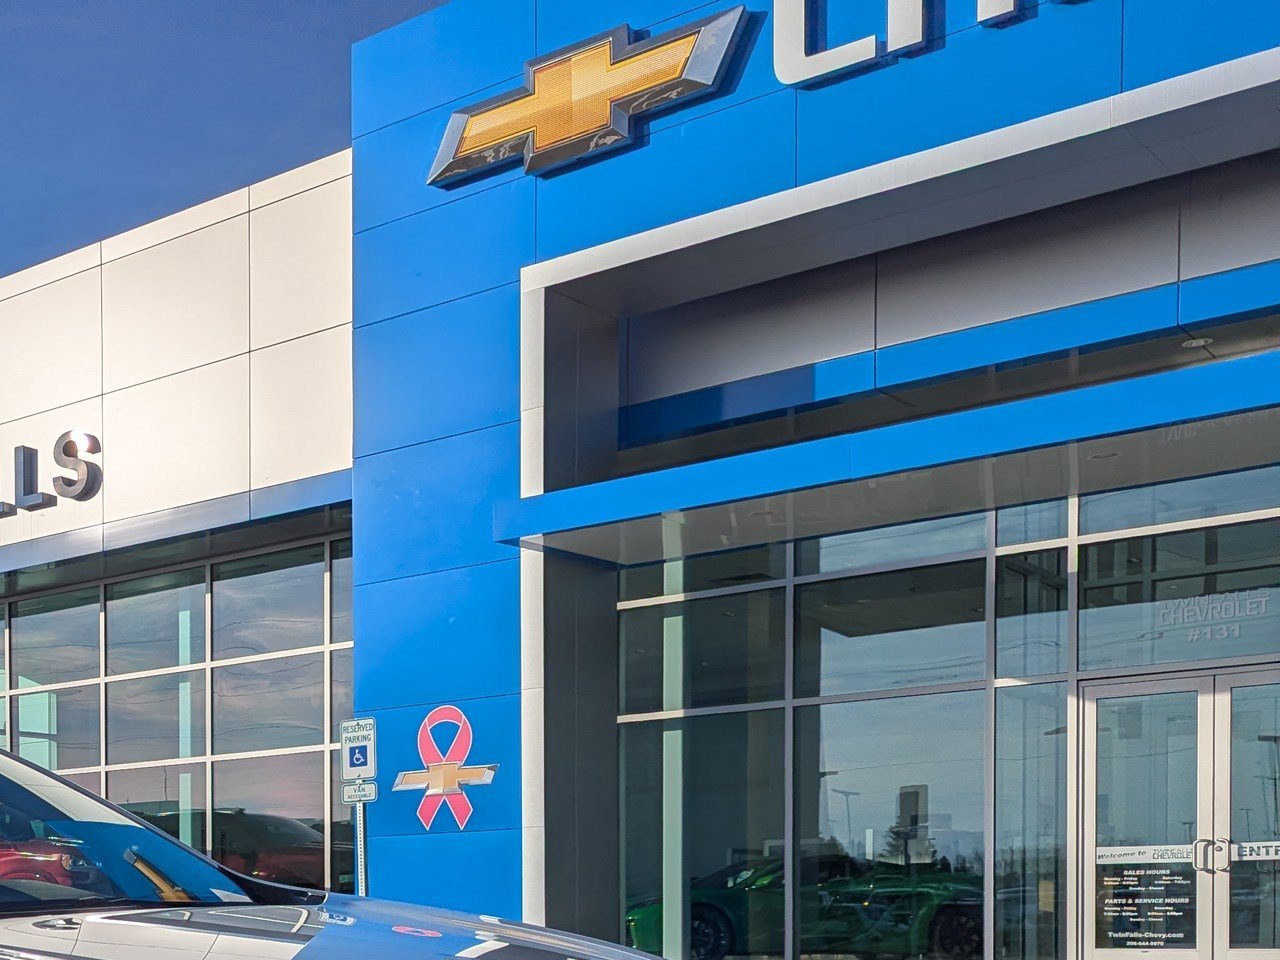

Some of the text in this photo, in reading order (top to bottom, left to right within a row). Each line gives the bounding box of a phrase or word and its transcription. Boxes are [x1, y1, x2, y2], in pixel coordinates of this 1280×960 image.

[1160, 597, 1271, 626] CHEVROLET
[1188, 623, 1240, 642] #131
[342, 723, 373, 734] RESERVED
[344, 734, 372, 744] PARKING
[353, 786, 366, 794] VAN
[1097, 851, 1136, 860] Welcome
